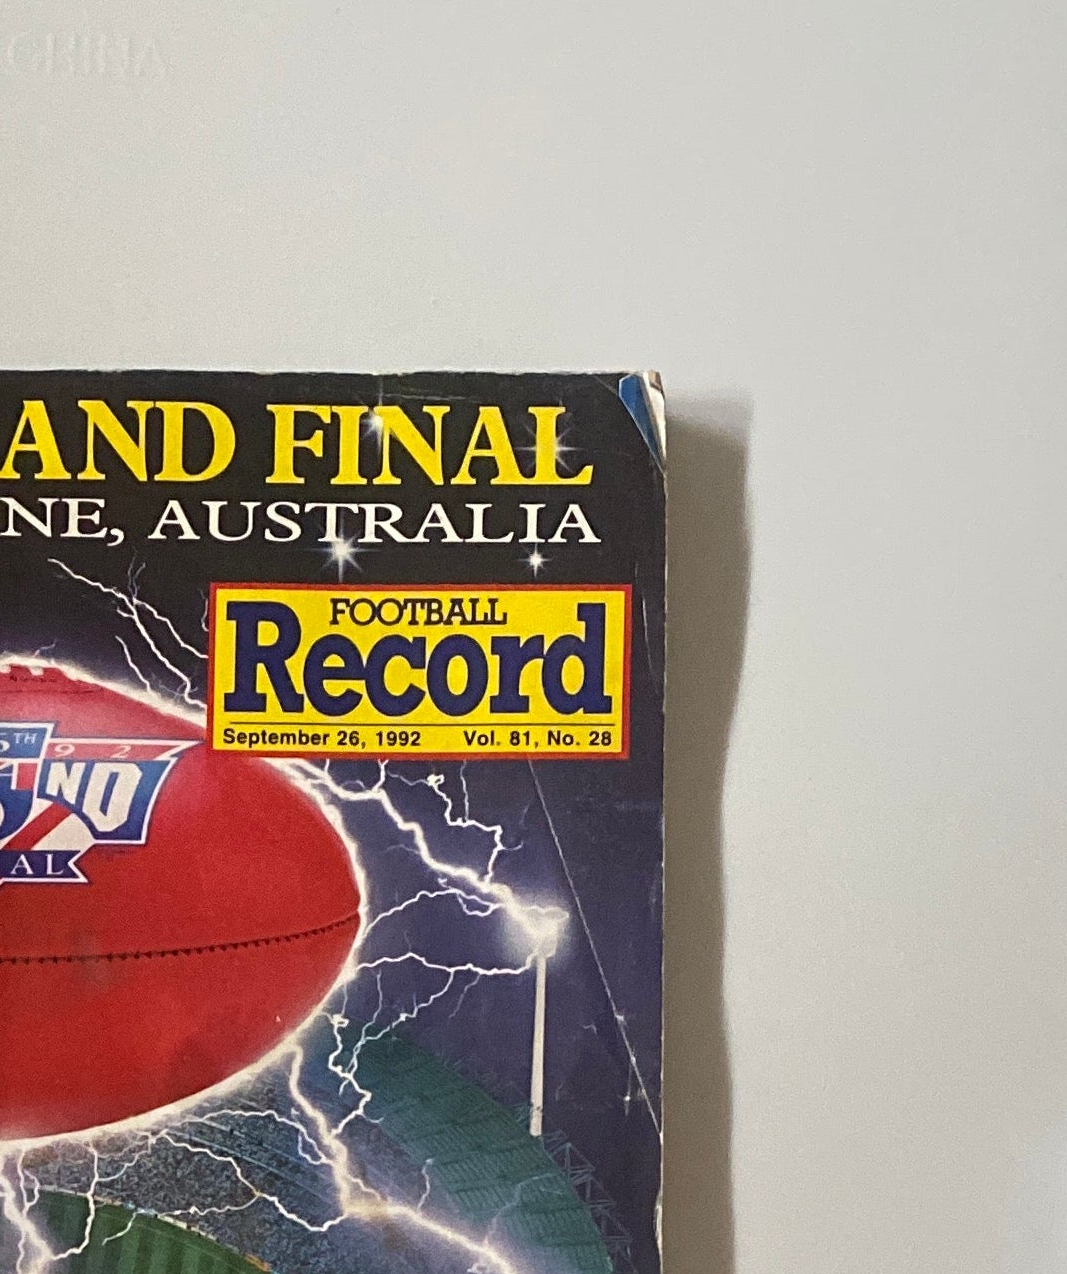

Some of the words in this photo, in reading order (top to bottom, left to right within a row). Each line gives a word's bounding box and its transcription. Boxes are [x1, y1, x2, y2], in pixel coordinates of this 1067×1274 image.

[266, 404, 593, 486] FINAL
[147, 499, 601, 544] AUSTRALIA
[329, 597, 508, 628] FOOTBALL
[223, 600, 613, 718] Record
[222, 727, 330, 750] September
[336, 729, 369, 750] 26,
[375, 729, 422, 747] 1992
[462, 729, 503, 747] Vol.
[508, 729, 541, 750] 81,
[546, 730, 581, 747] No.
[584, 730, 613, 747] 28
